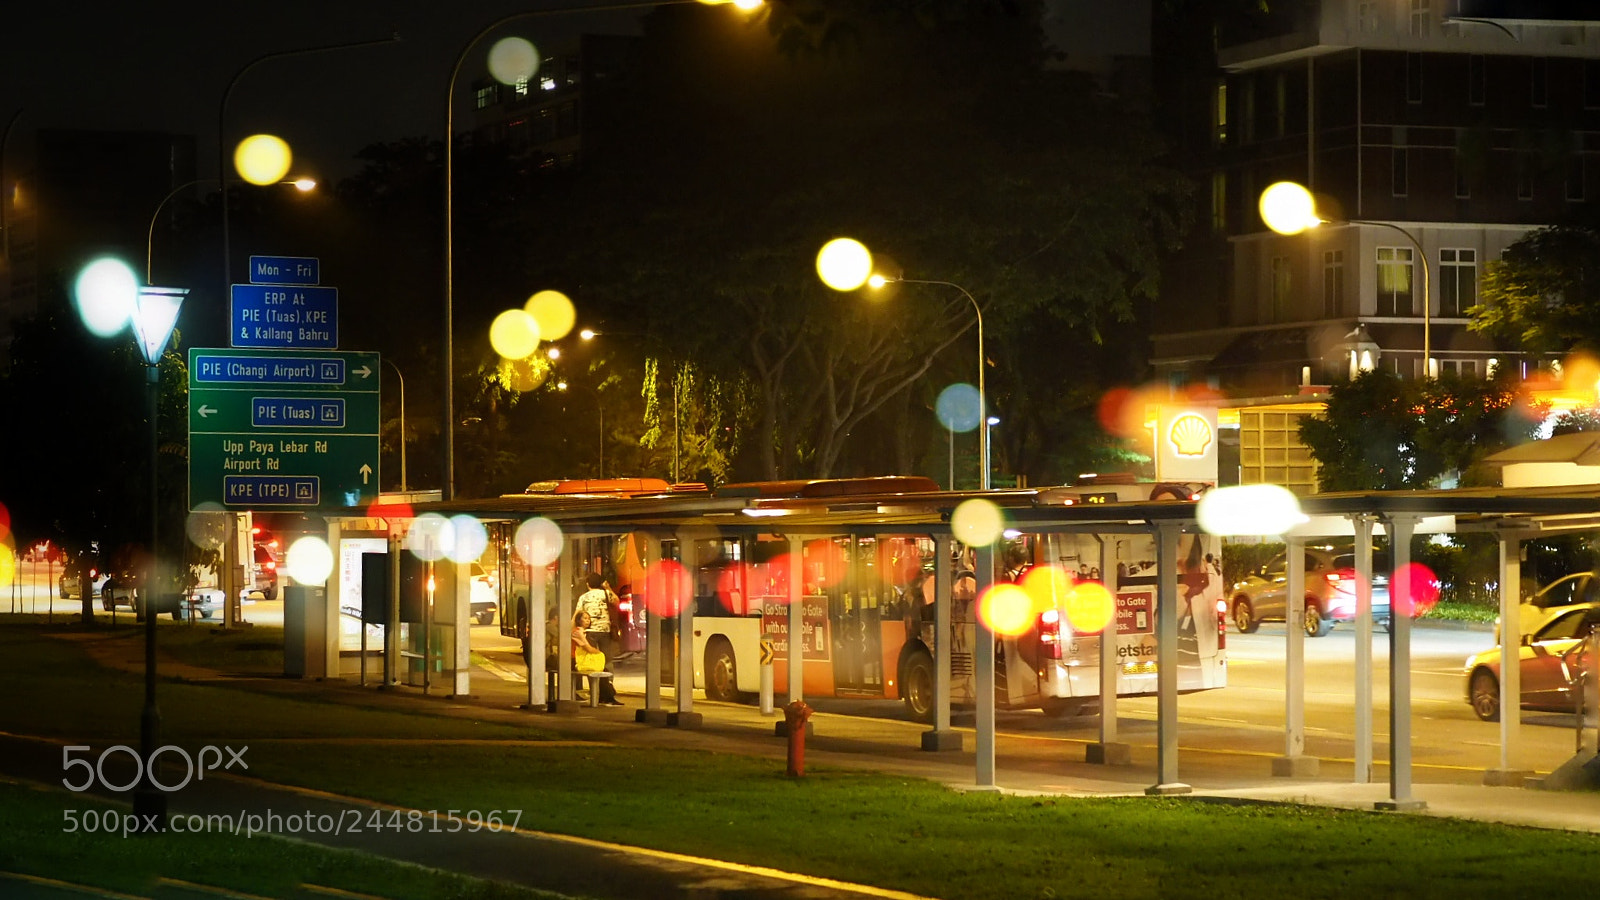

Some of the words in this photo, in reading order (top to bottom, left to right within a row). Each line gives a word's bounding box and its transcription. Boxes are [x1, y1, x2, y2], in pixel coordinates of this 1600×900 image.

[258, 263, 279, 276] Mon
[297, 264, 312, 277] Fri
[265, 292, 286, 305] ERP
[293, 292, 305, 305] At
[242, 309, 260, 322] PIE
[241, 327, 249, 339] &
[255, 327, 293, 343] Kallang
[299, 328, 329, 341] Bahru
[202, 363, 221, 376] PIE
[227, 364, 267, 380] (Changi
[273, 364, 315, 380] Airport)
[258, 406, 276, 419] PIE
[283, 406, 315, 420] (Tuas)
[223, 440, 243, 456] Upp
[249, 441, 274, 456] Paya
[280, 440, 307, 453] Lebar
[315, 441, 327, 453] Rd
[224, 458, 261, 473] Airport
[267, 458, 279, 471] Rd
[230, 484, 252, 497] KPE
[259, 484, 289, 498] (TPE)
[1127, 597, 1147, 606] Gate
[766, 604, 775, 616] Go
[807, 604, 823, 616] Gate
[766, 621, 780, 633] with
